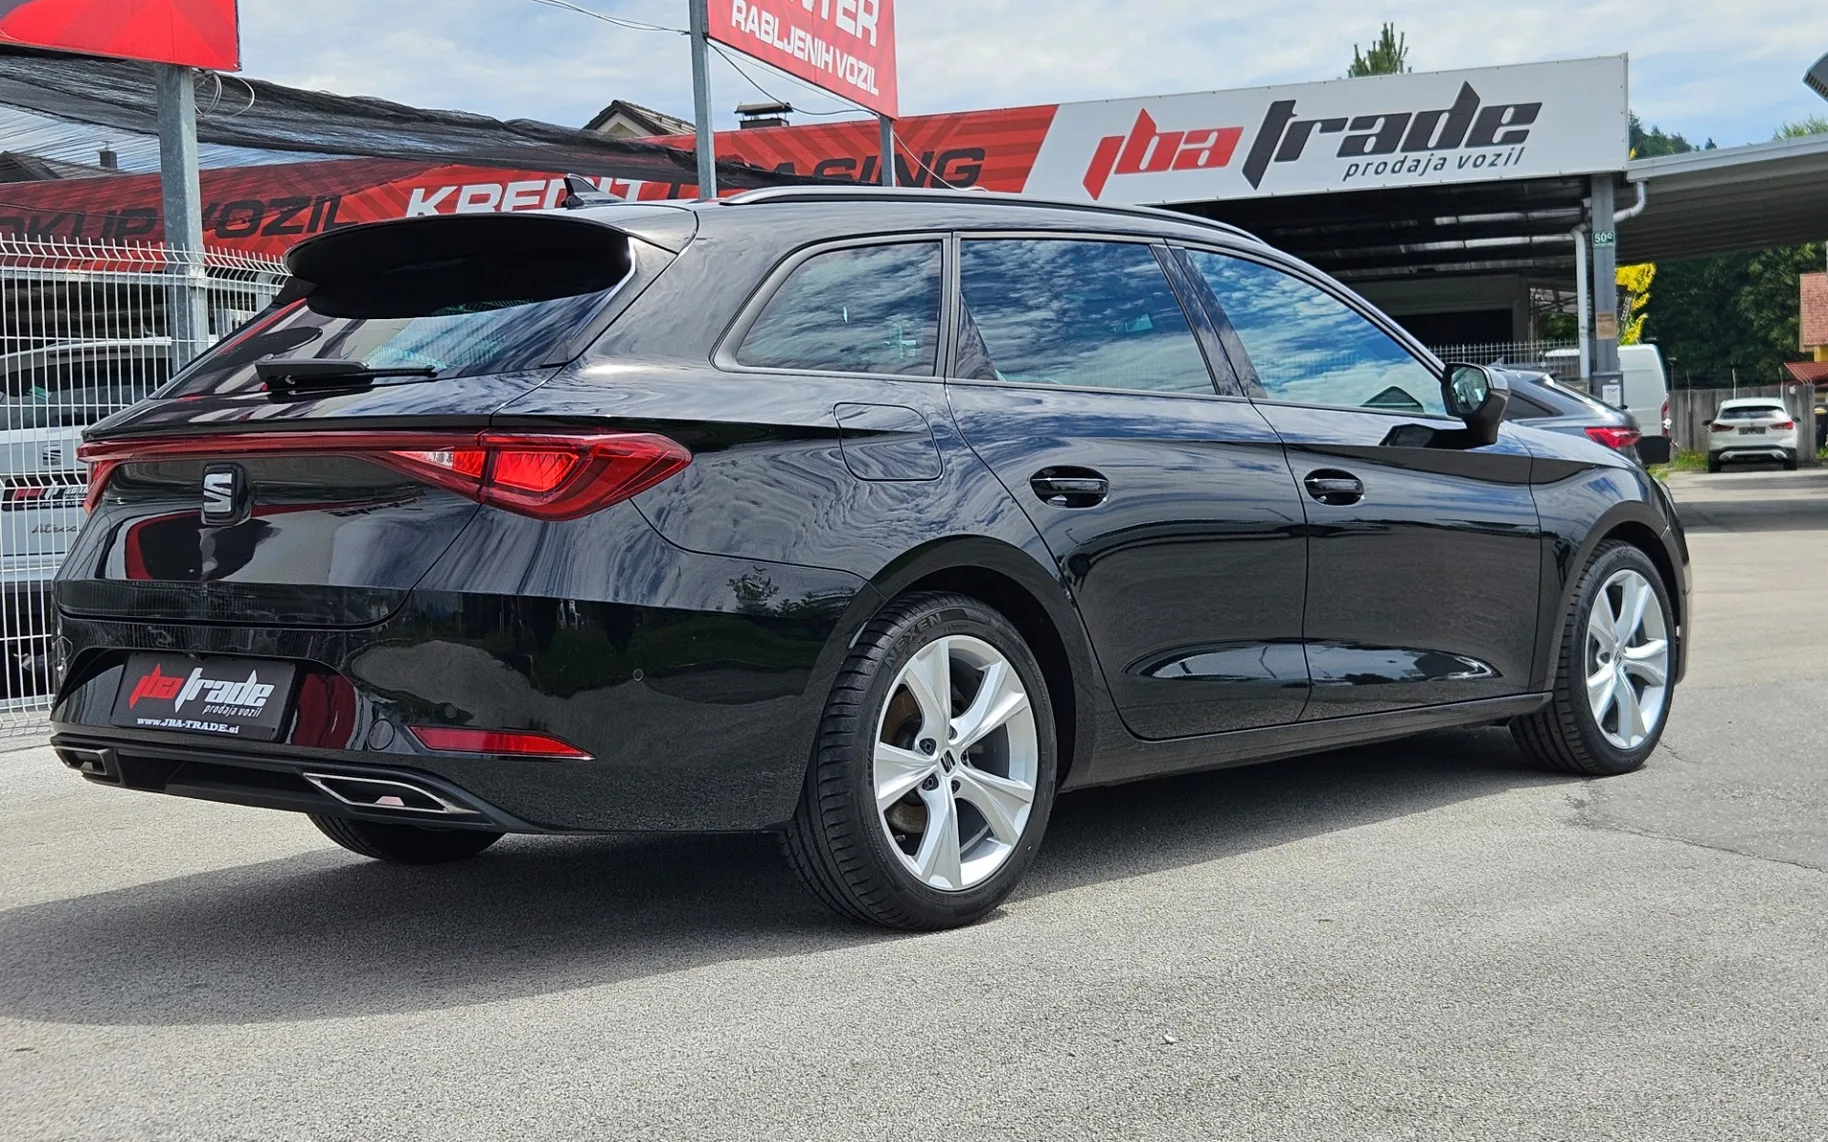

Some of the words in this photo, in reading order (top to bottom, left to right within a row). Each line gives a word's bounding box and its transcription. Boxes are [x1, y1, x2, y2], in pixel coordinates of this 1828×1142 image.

[731, 0, 834, 73] RABLJENIH
[834, 49, 879, 96] VOZIL
[1341, 153, 1448, 182] prodaja
[1456, 147, 1525, 169] vozil
[884, 612, 943, 668] NEXEN
[137, 718, 239, 734] www.JBA-TRADE.si
[202, 704, 238, 717] prodaja
[238, 707, 263, 718] vozil
